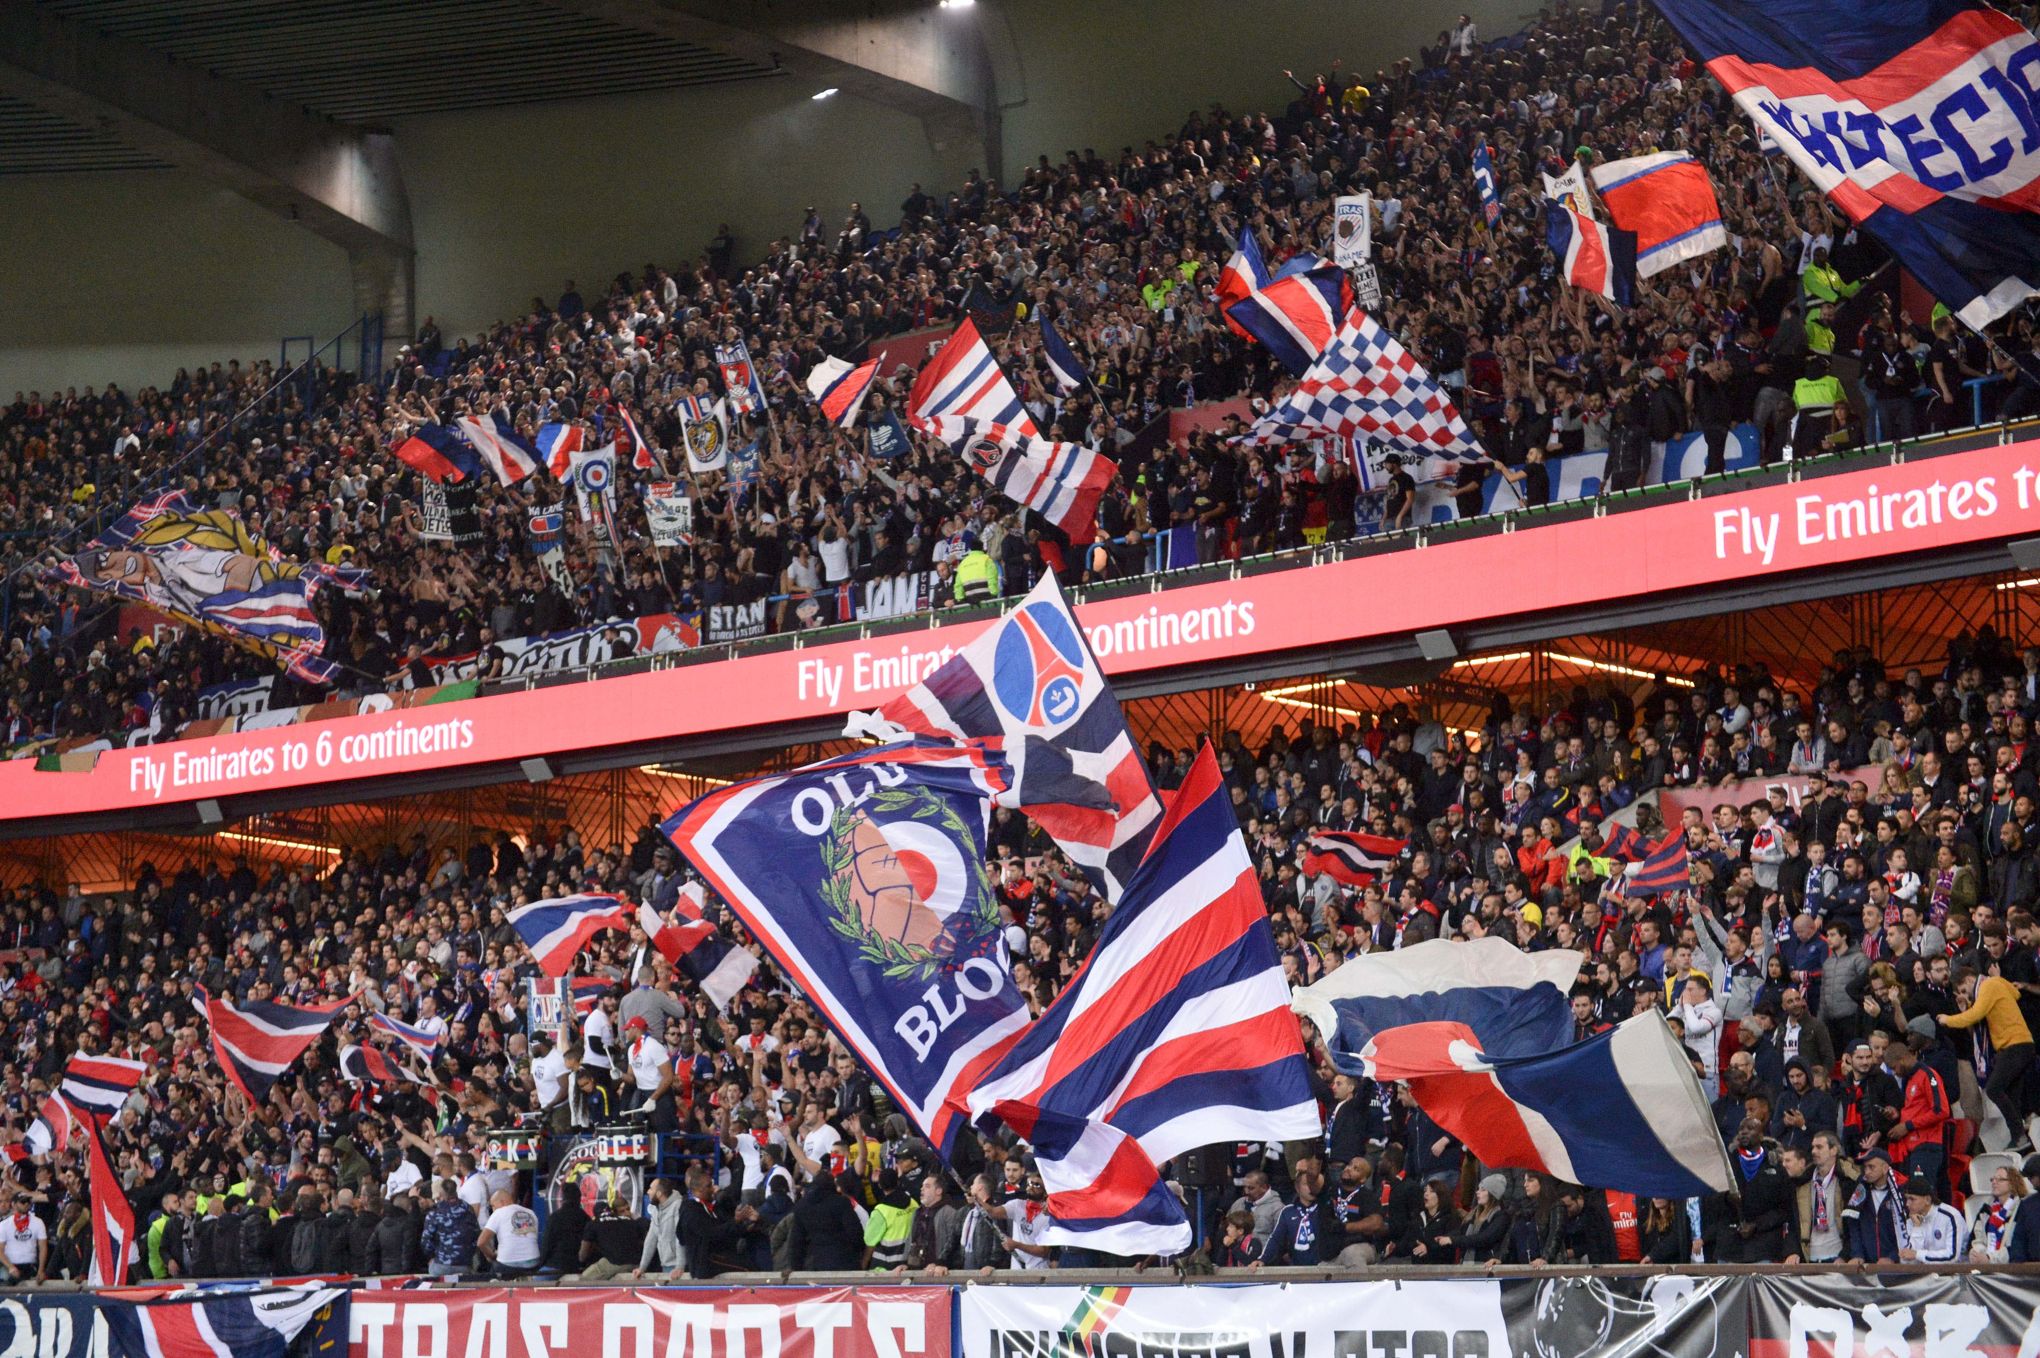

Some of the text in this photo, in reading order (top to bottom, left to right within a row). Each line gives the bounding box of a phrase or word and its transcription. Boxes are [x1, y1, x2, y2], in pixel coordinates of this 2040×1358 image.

[1714, 466, 2040, 564] Fly Emirates t
[798, 658, 843, 707] Fly
[853, 643, 964, 693] Emirat
[131, 718, 473, 798] Fly Emirates to 6 continents
[894, 952, 1010, 1063] BLO
